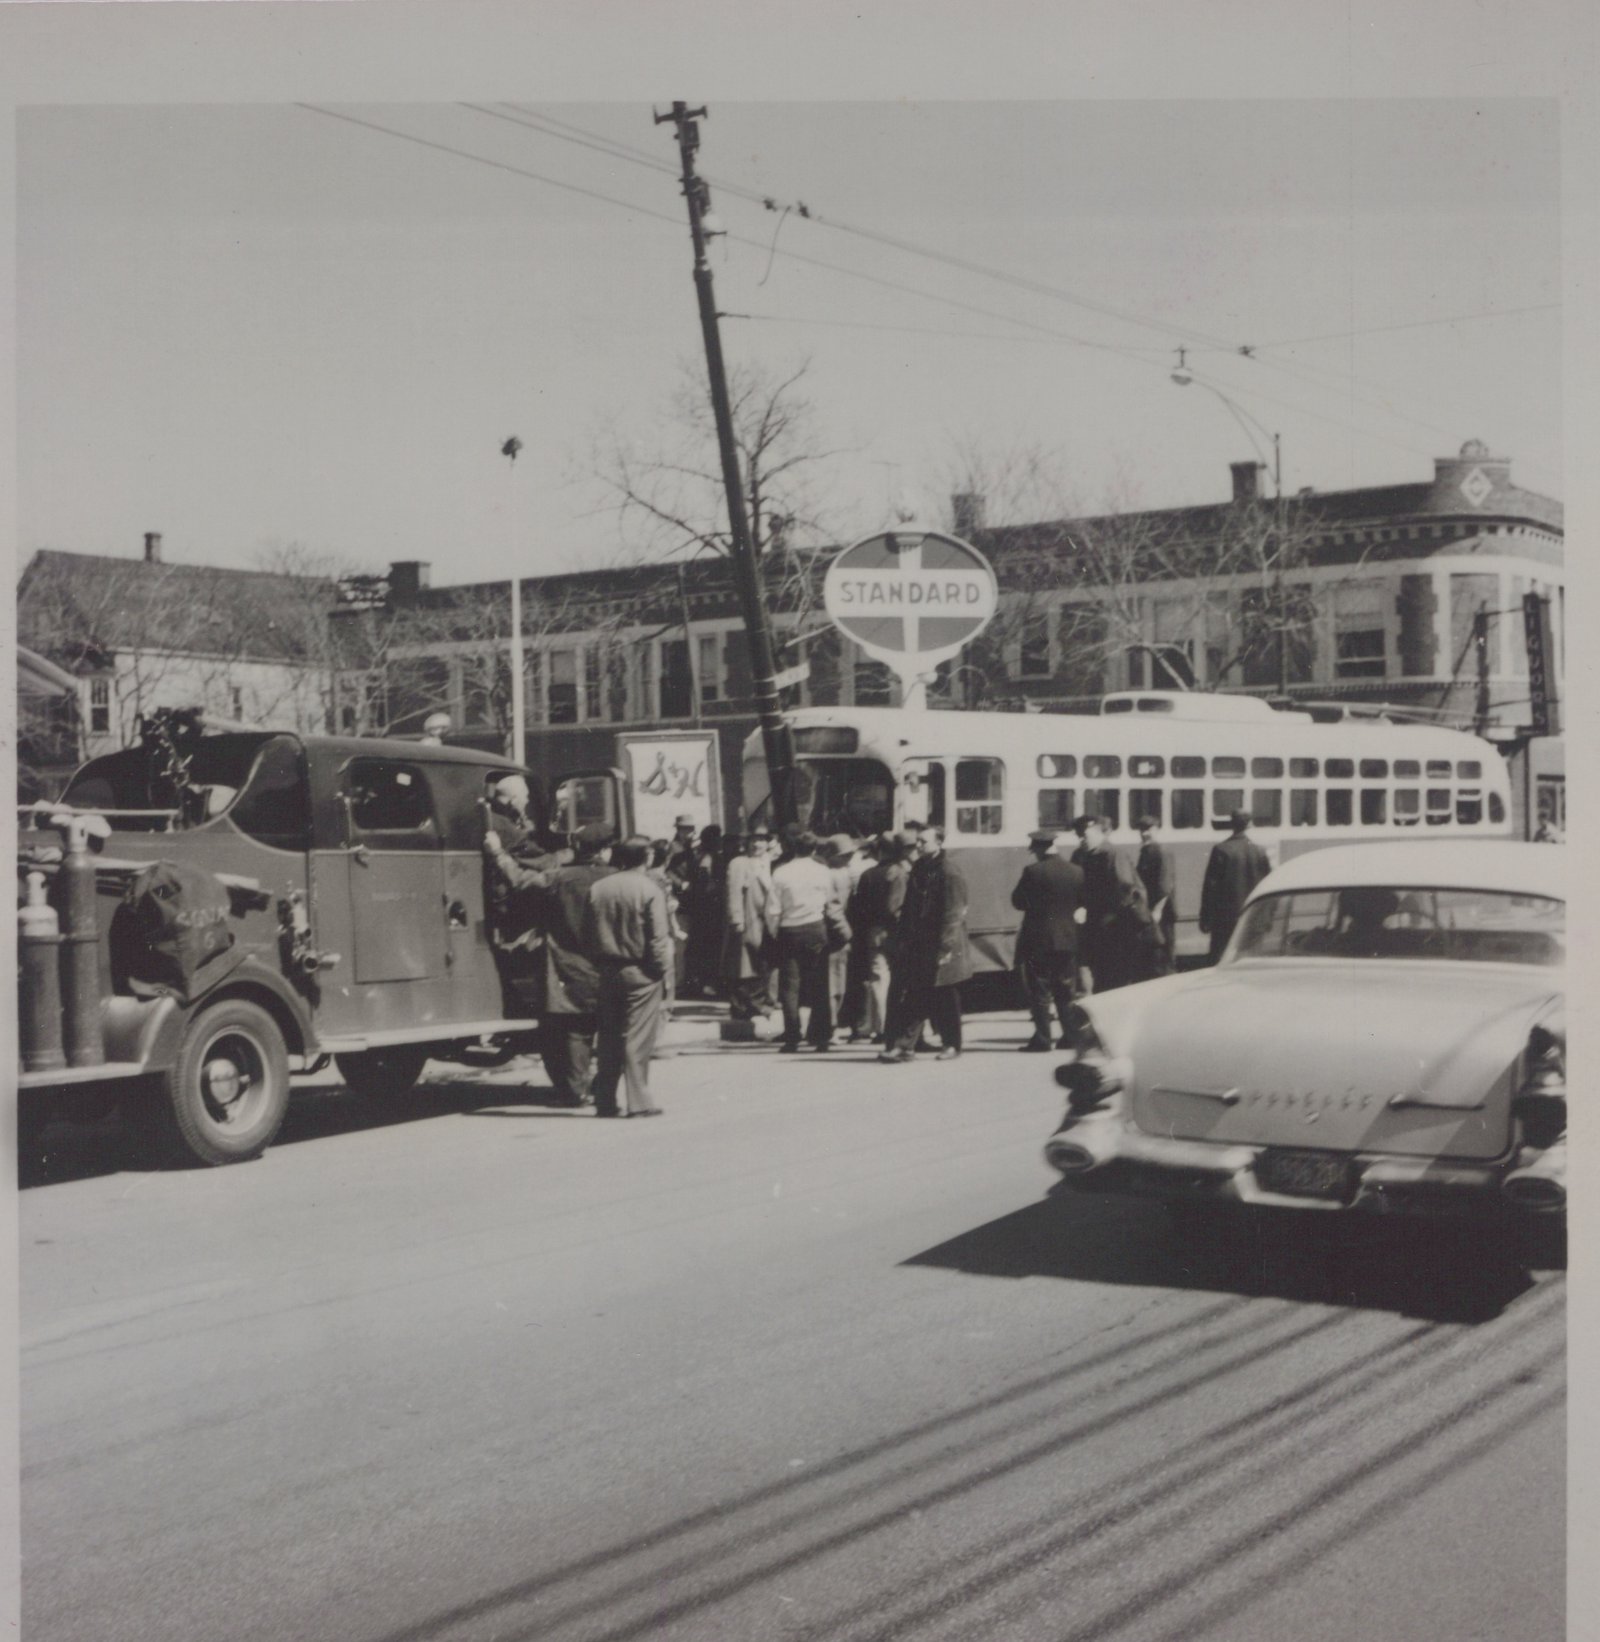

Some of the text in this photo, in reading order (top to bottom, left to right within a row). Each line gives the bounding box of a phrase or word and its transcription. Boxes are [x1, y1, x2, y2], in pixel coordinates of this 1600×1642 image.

[840, 580, 981, 606] STANDARD
[1526, 600, 1547, 723] LIQUORS
[203, 930, 216, 950] 6
